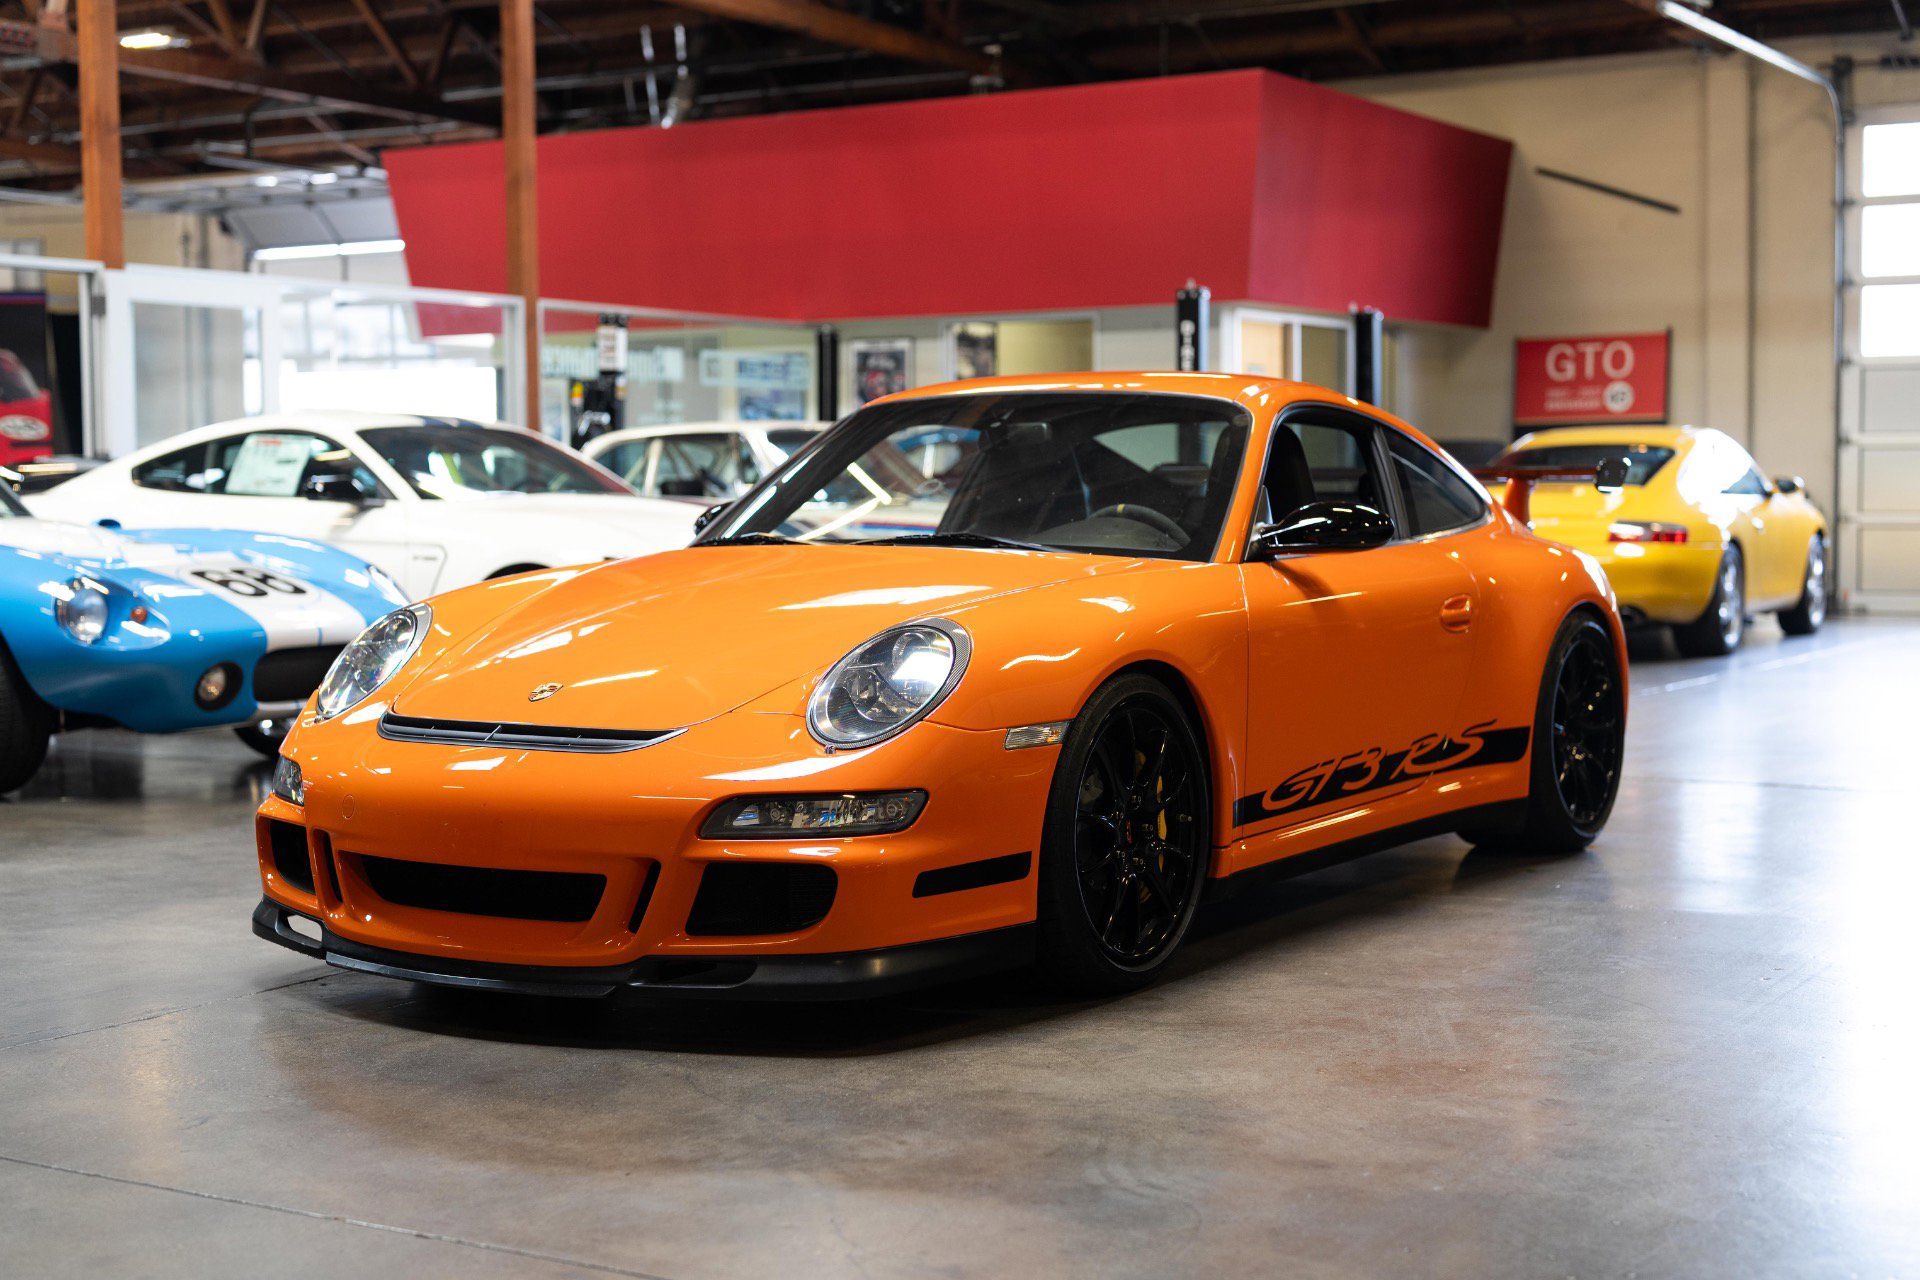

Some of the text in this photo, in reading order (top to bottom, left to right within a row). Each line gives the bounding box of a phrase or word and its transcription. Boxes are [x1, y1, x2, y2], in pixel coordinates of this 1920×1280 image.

[1546, 341, 1634, 382] GTO
[1262, 719, 1498, 811] GT3 RS
